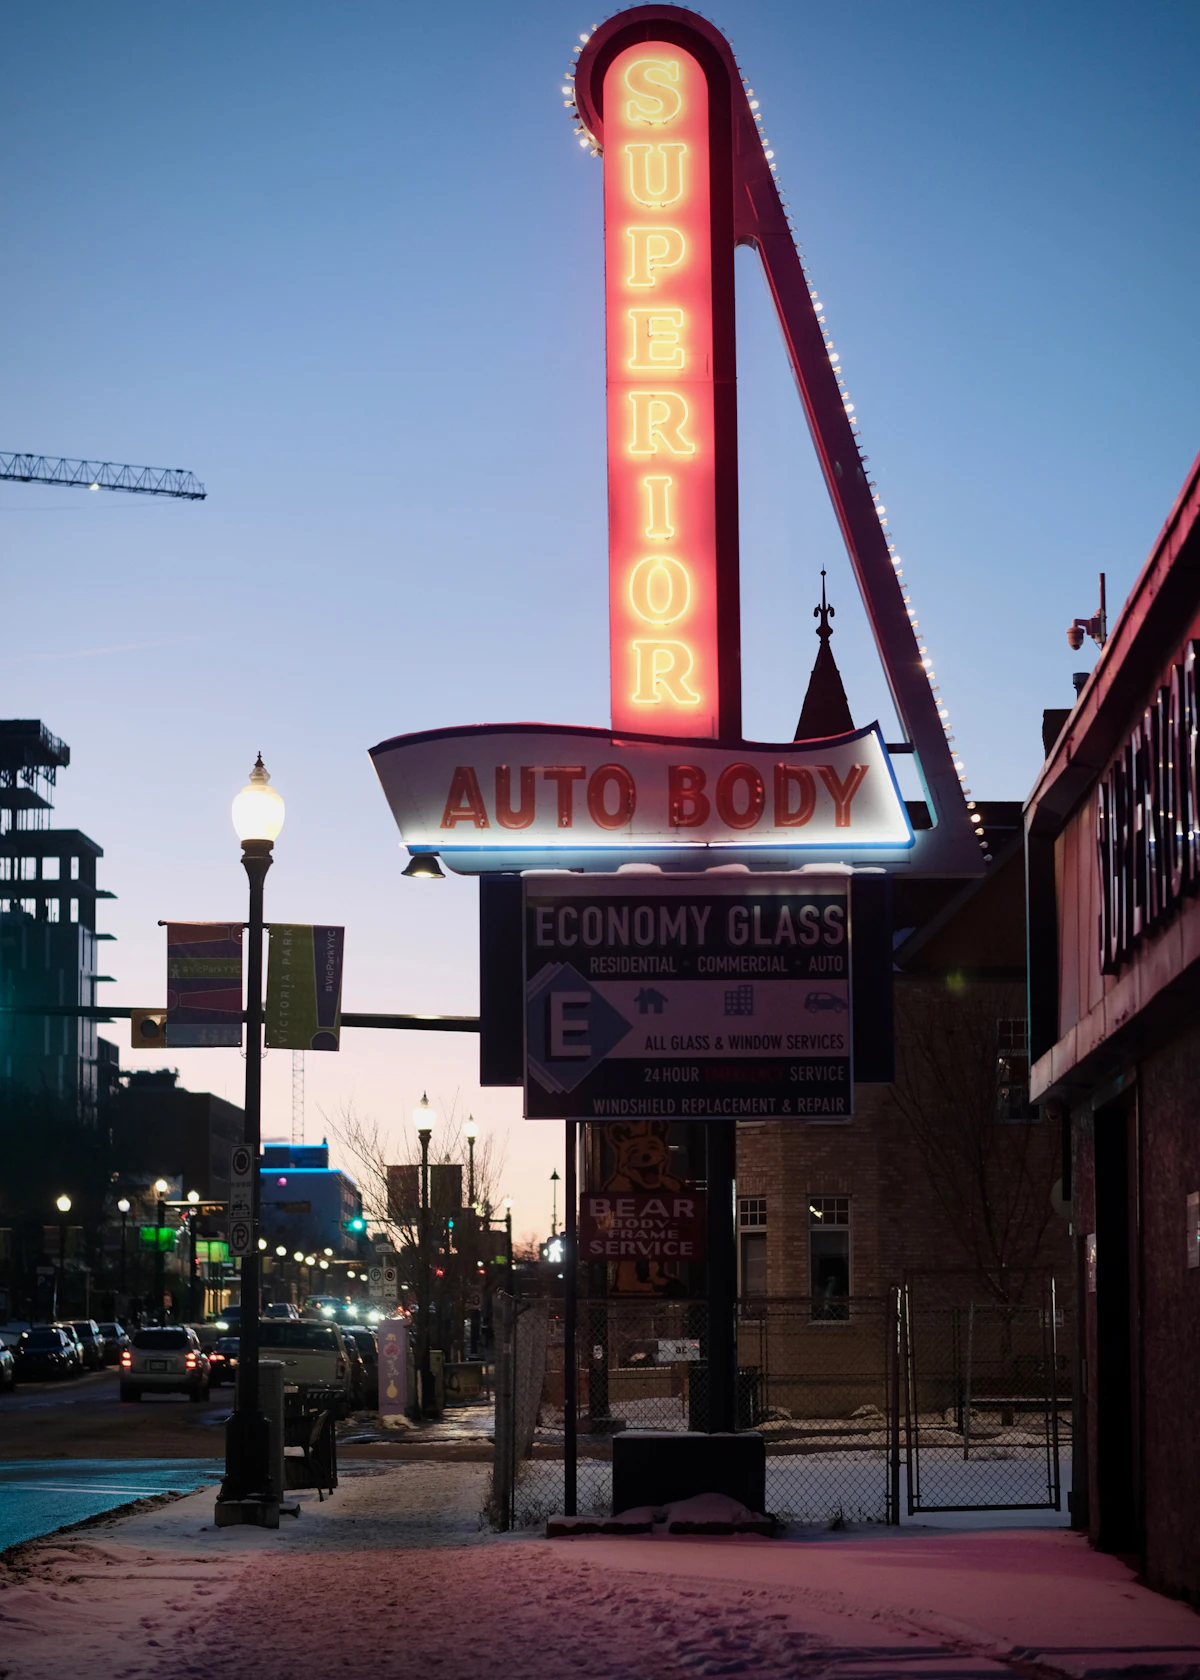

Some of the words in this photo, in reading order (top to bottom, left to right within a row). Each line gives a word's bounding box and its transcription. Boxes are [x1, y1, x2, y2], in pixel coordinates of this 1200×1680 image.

[624, 59, 701, 705] SUPERIOR
[440, 763, 636, 830] AUTO
[668, 762, 870, 830] BODY
[535, 905, 711, 947] ECONOMY
[728, 904, 845, 946] GLASS
[282, 928, 293, 965] PARK
[590, 956, 677, 973] RESIDENTIAL
[697, 955, 788, 973] COMMERCIAL
[808, 955, 844, 972] AUTO
[550, 990, 592, 1057] E
[644, 1035, 667, 1051] ALL
[670, 1035, 710, 1051] GLASS
[714, 1035, 725, 1051] &
[728, 1035, 782, 1050] WINDOW
[786, 1034, 844, 1050] SERVICES
[644, 1068, 660, 1082] 24
[662, 1067, 699, 1082] HOUR
[790, 1066, 845, 1082] SERVICE
[593, 1099, 676, 1114] WINDSHIELD
[681, 1098, 775, 1114] REPLACEMENT
[782, 1098, 792, 1113] &
[797, 1097, 845, 1113] REPAIR
[589, 1198, 695, 1218] BEAR
[608, 1229, 679, 1239] FRAME
[589, 1240, 693, 1256] SERVICE
